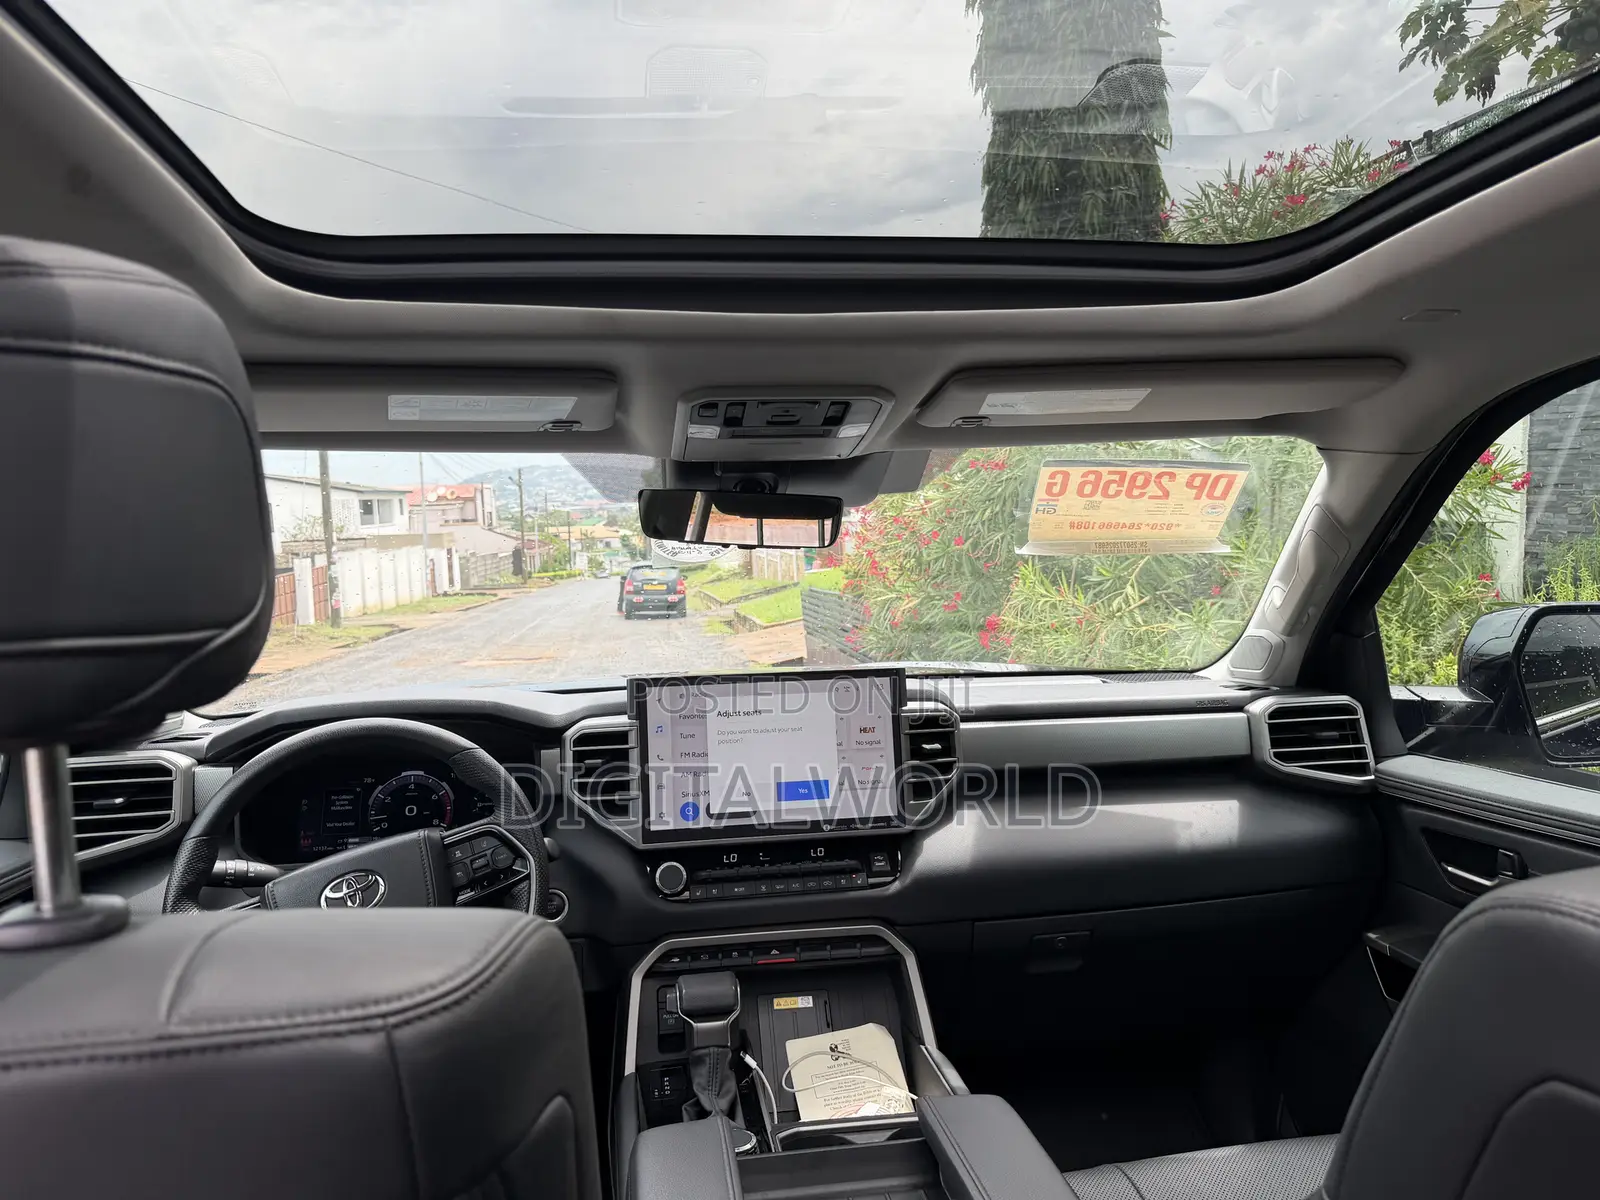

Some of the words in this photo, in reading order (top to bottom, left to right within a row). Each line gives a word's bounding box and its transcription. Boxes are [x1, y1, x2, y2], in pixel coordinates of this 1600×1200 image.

[717, 710, 741, 719] Adjust
[743, 709, 762, 717] seats
[860, 726, 875, 734] HEAT
[717, 737, 744, 746] position?
[681, 789, 711, 798] SiriusXM
[405, 805, 417, 816] 0
[810, 847, 825, 857] LO
[723, 853, 738, 863] LO
